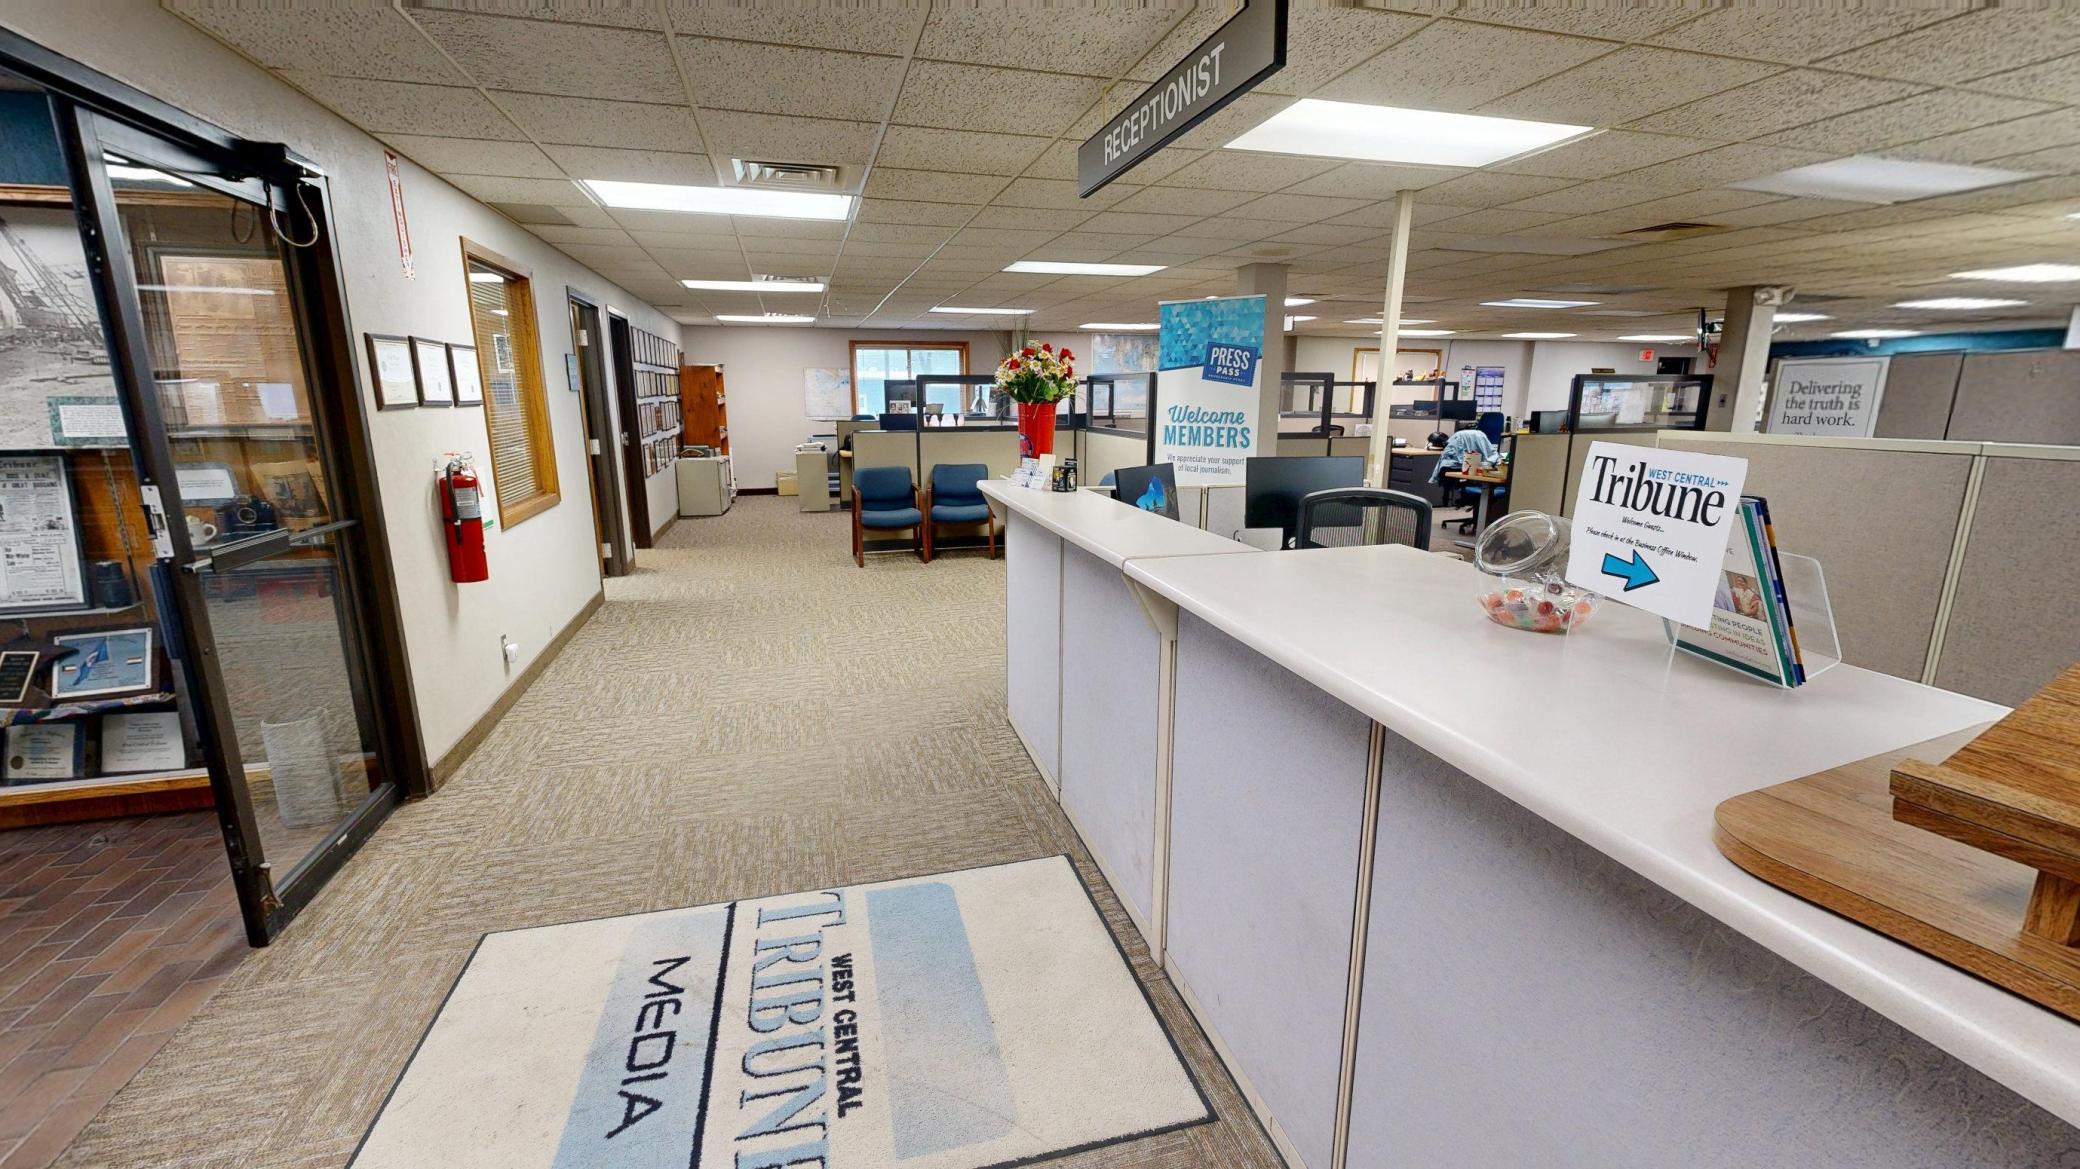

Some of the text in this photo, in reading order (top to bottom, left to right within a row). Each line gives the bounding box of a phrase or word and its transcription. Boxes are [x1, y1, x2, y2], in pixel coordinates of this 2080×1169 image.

[1104, 41, 1225, 166] RECEPTIONIST
[1210, 346, 1251, 370] PRESS
[1216, 366, 1240, 377] PASS
[1789, 380, 1862, 399] Delivering
[1785, 396, 1861, 410] the truth is
[1168, 404, 1246, 425] Welcome
[1781, 411, 1856, 426] hard work.
[1163, 425, 1251, 449] MEMBERS
[1177, 455, 1207, 464] appreciate
[1207, 457, 1221, 465] your
[1222, 457, 1245, 466] support
[1185, 464, 1199, 473] local
[1648, 467, 1716, 488] WEST CENTRAL
[1590, 455, 1726, 527] Tribune
[1621, 516, 1643, 528] Welcome
[1586, 526, 1600, 537] Please
[1600, 530, 1613, 541] check
[1625, 536, 1634, 545] the
[1634, 539, 1657, 552] Business
[1657, 545, 1674, 556] Office
[1731, 620, 1763, 635] PEOPLE
[1713, 632, 1769, 656] COMMUNITIES
[831, 952, 863, 1119] WEST CENTRAL
[605, 955, 691, 1139] MEDIA
